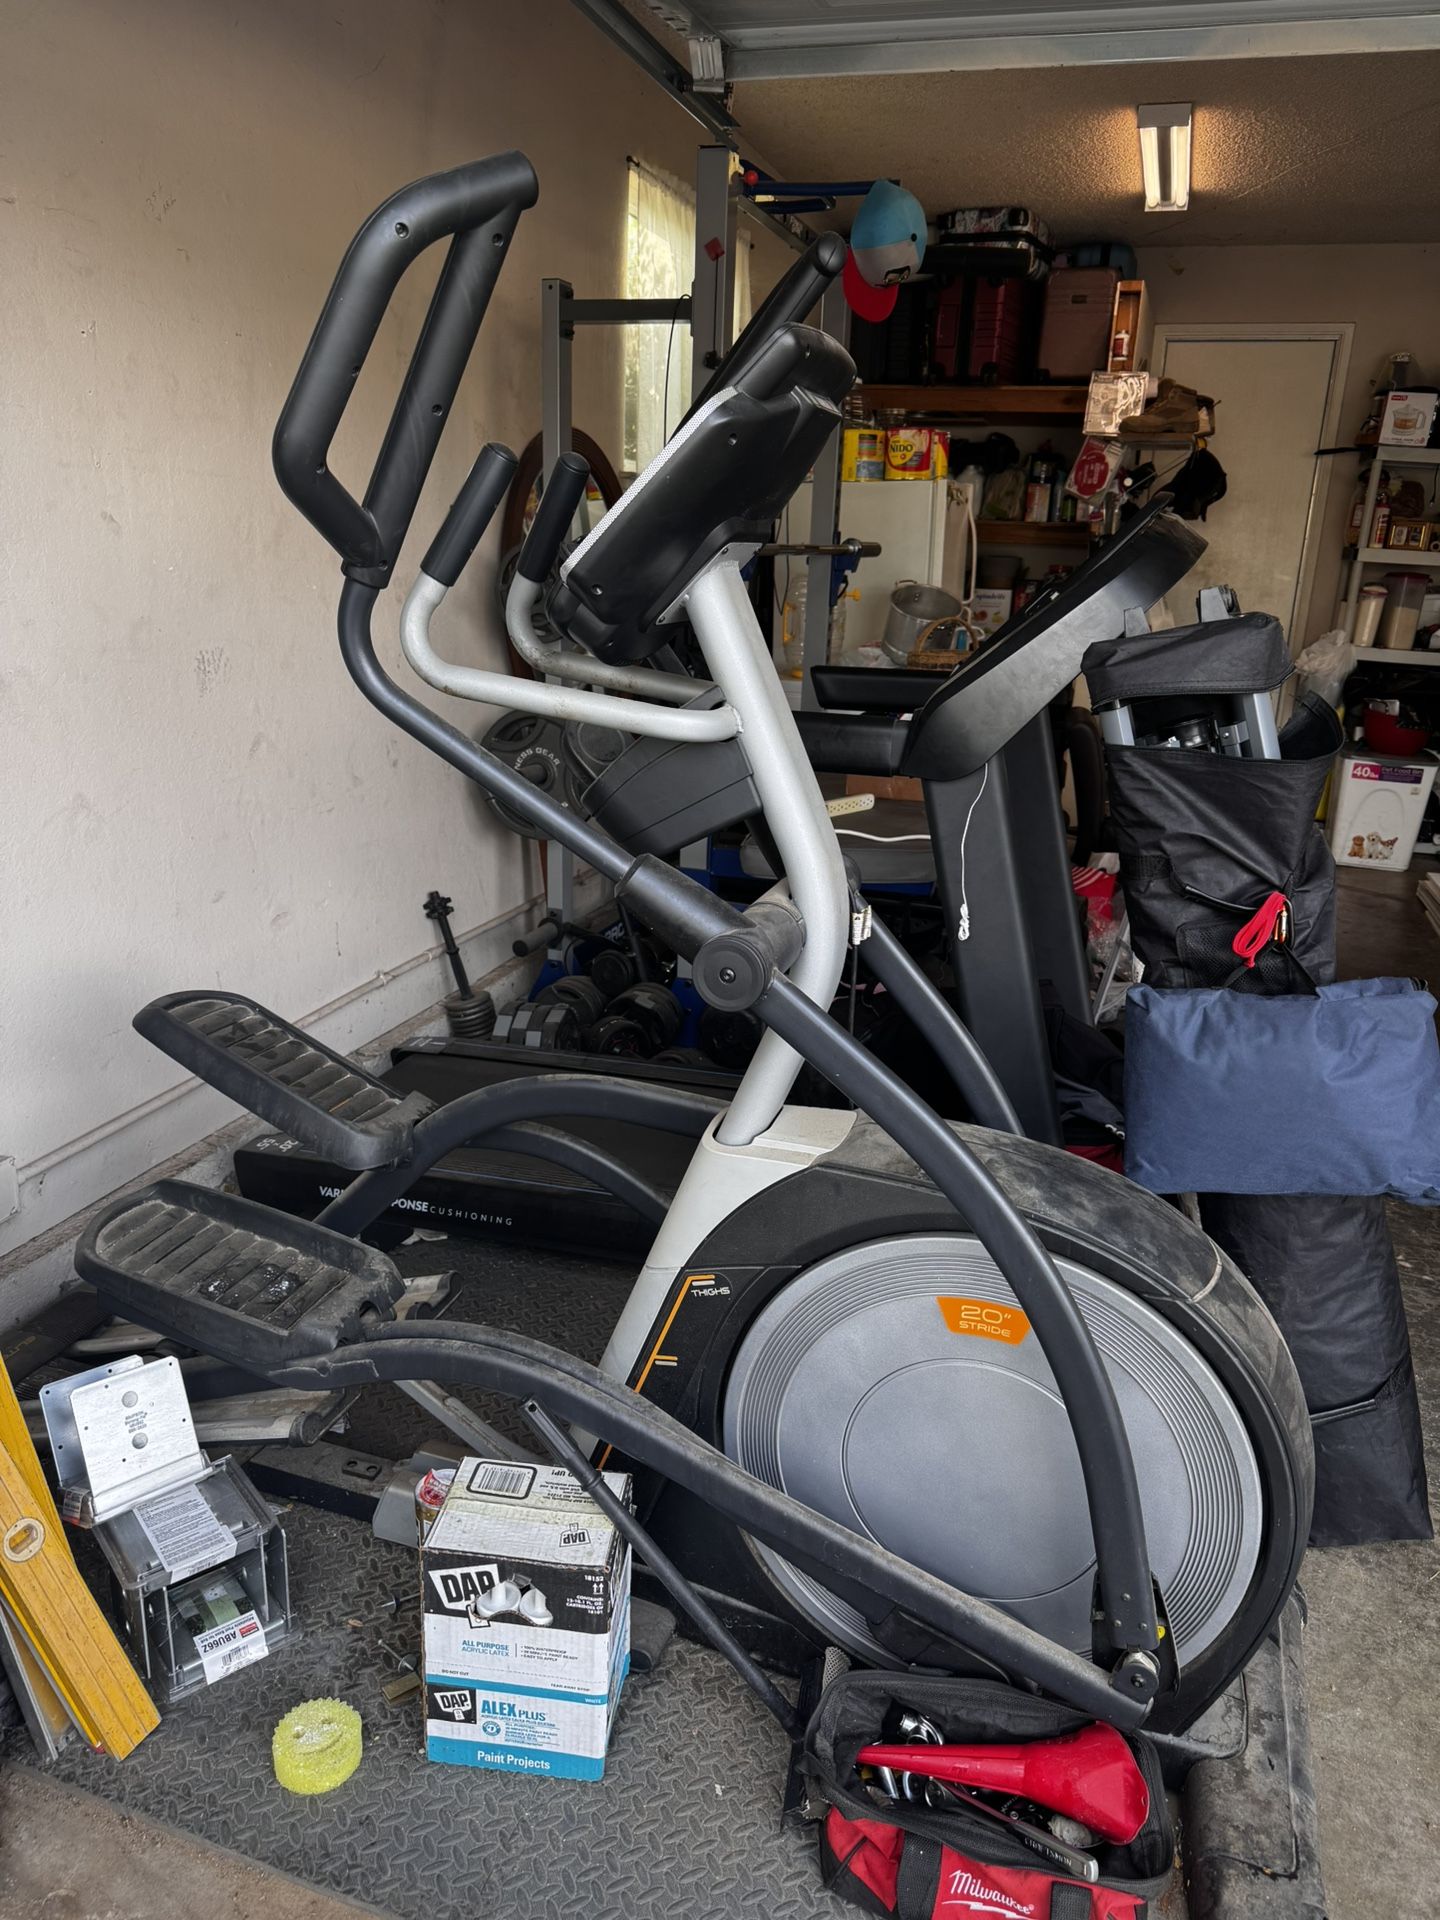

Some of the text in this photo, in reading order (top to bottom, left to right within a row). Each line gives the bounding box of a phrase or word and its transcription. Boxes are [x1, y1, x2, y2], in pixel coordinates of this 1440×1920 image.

[890, 443, 914, 453] NIDO
[514, 747, 561, 770] NESS GEAR
[430, 1206, 513, 1226] CUSHIONING
[961, 1305, 1012, 1324] 20"
[959, 1320, 1012, 1337] STRIDE
[563, 1532, 586, 1545] DAP
[440, 1570, 496, 1604] DAP
[201, 1631, 237, 1653] ABU66Z
[462, 1639, 509, 1651] ALL PURPOSE
[462, 1646, 510, 1657] ACRYLIC LATEX
[440, 1692, 467, 1709] DAP
[481, 1700, 546, 1721] ALEX PLUS
[477, 1750, 550, 1770] Paint Projects
